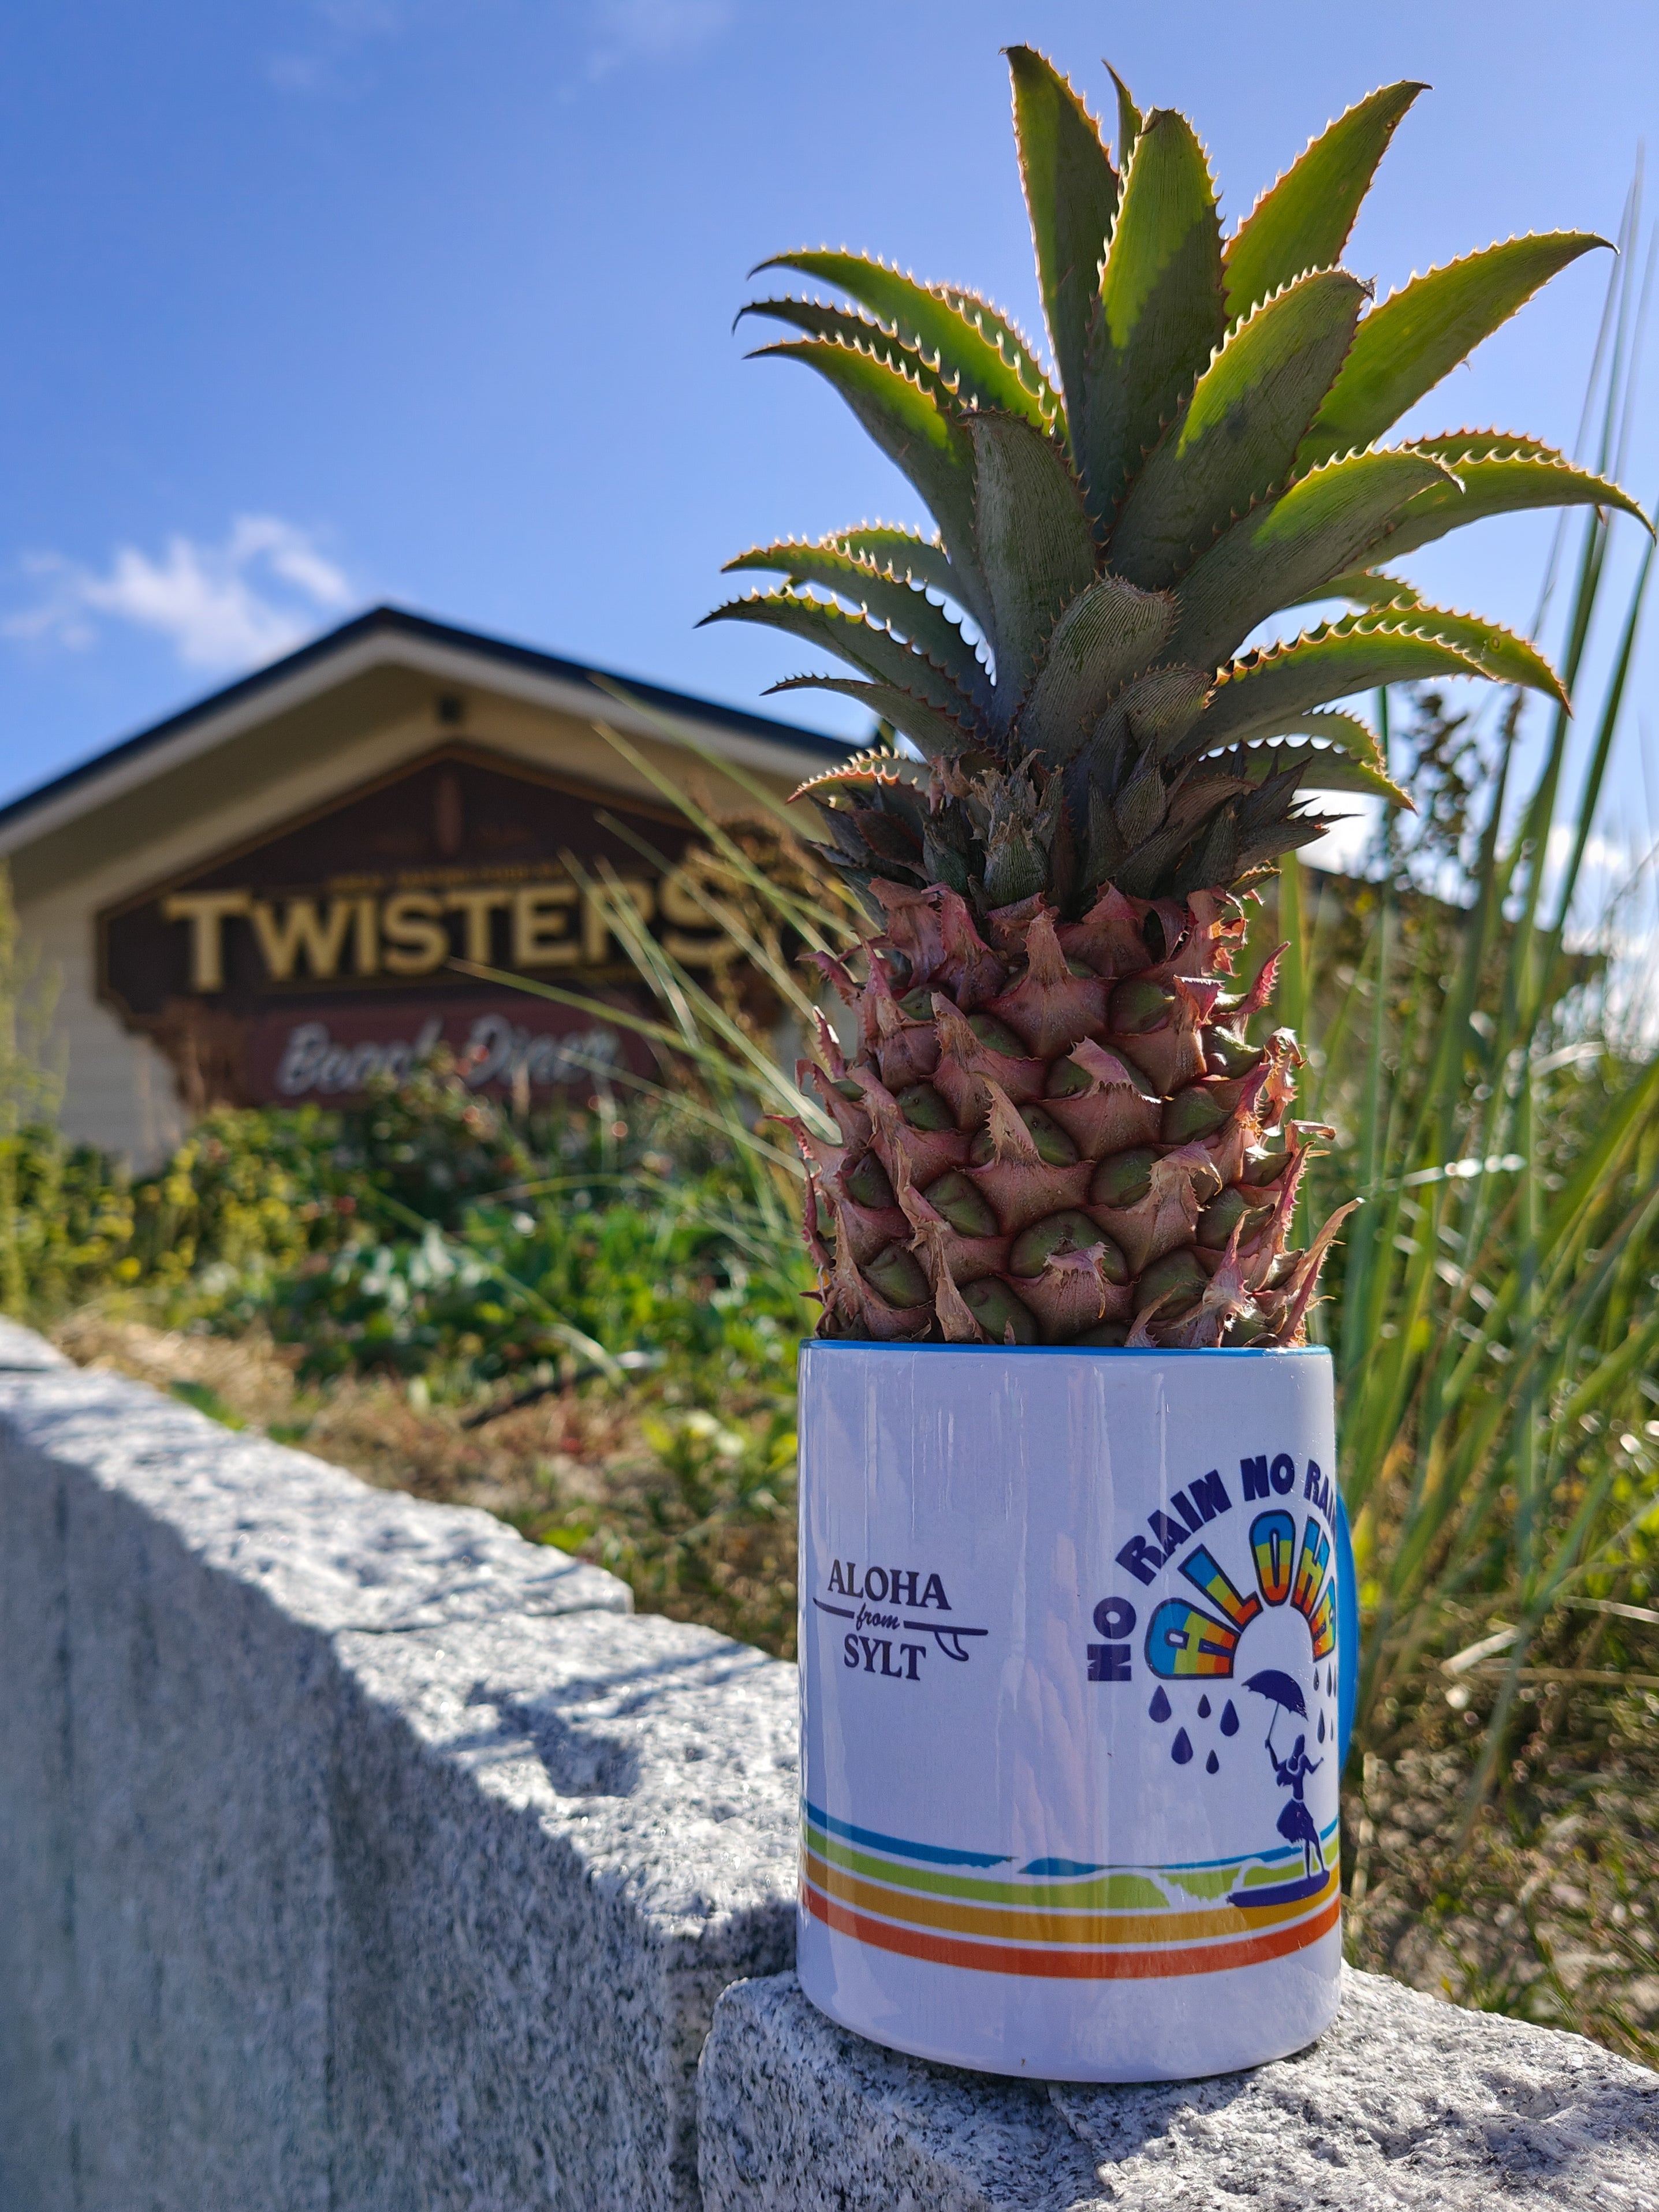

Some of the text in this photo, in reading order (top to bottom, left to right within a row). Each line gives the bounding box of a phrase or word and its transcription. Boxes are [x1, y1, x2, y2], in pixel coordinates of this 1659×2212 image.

[164, 866, 758, 994] TWISTERS
[827, 1558, 953, 1611] ALOHA
[1087, 1596, 1137, 1681] NO
[1115, 1468, 1233, 1587] RAIN
[1240, 1453, 1295, 1502] NO
[1144, 1509, 1337, 1680] ALOHA
[844, 1632, 927, 1681] SYLT
[856, 1602, 901, 1631] from
